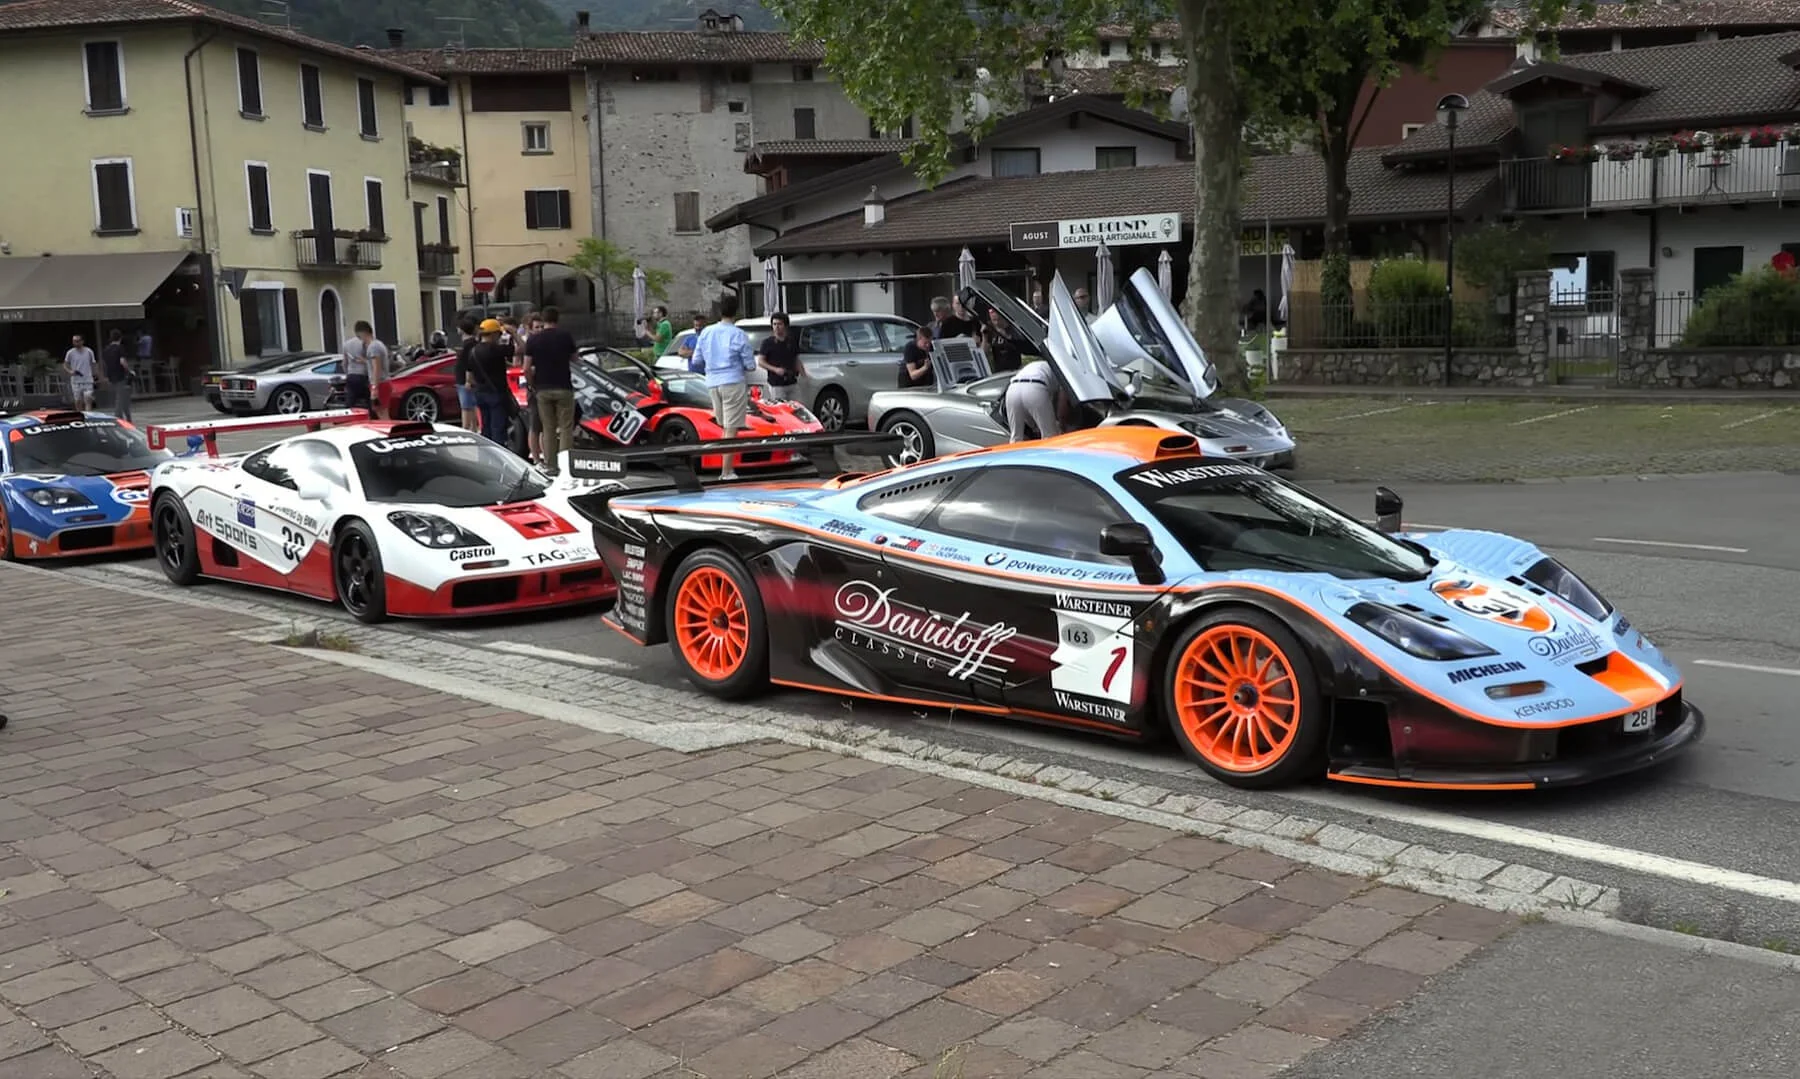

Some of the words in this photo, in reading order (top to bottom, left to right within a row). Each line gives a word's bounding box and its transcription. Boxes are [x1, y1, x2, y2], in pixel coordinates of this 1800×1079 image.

[1023, 231, 1049, 240] AGUST
[1063, 233, 1105, 244] GELATERIA
[1105, 230, 1158, 242] ARTIGIANALE
[1069, 224, 1092, 235] BAR
[1098, 219, 1149, 233] BOUNTY
[608, 410, 641, 442] 60
[573, 459, 622, 473] MICHELIN
[196, 509, 213, 528] Art
[214, 515, 258, 551] Sports
[449, 547, 496, 562] Castrol
[521, 548, 565, 566] TAG
[1006, 558, 1072, 576] powered
[1072, 567, 1093, 581] by
[1092, 570, 1137, 582] BMW
[1055, 592, 1132, 618] WARSTEINER
[834, 580, 1017, 682] Davidoff
[1066, 629, 1089, 645] 163
[834, 627, 938, 670] CLASSIC
[1101, 646, 1128, 693] 1
[1446, 660, 1527, 685] MICHELIN
[1055, 691, 1127, 723] WARSTEINER
[1513, 697, 1576, 719] KENWOOD
[1631, 710, 1648, 728] 28
